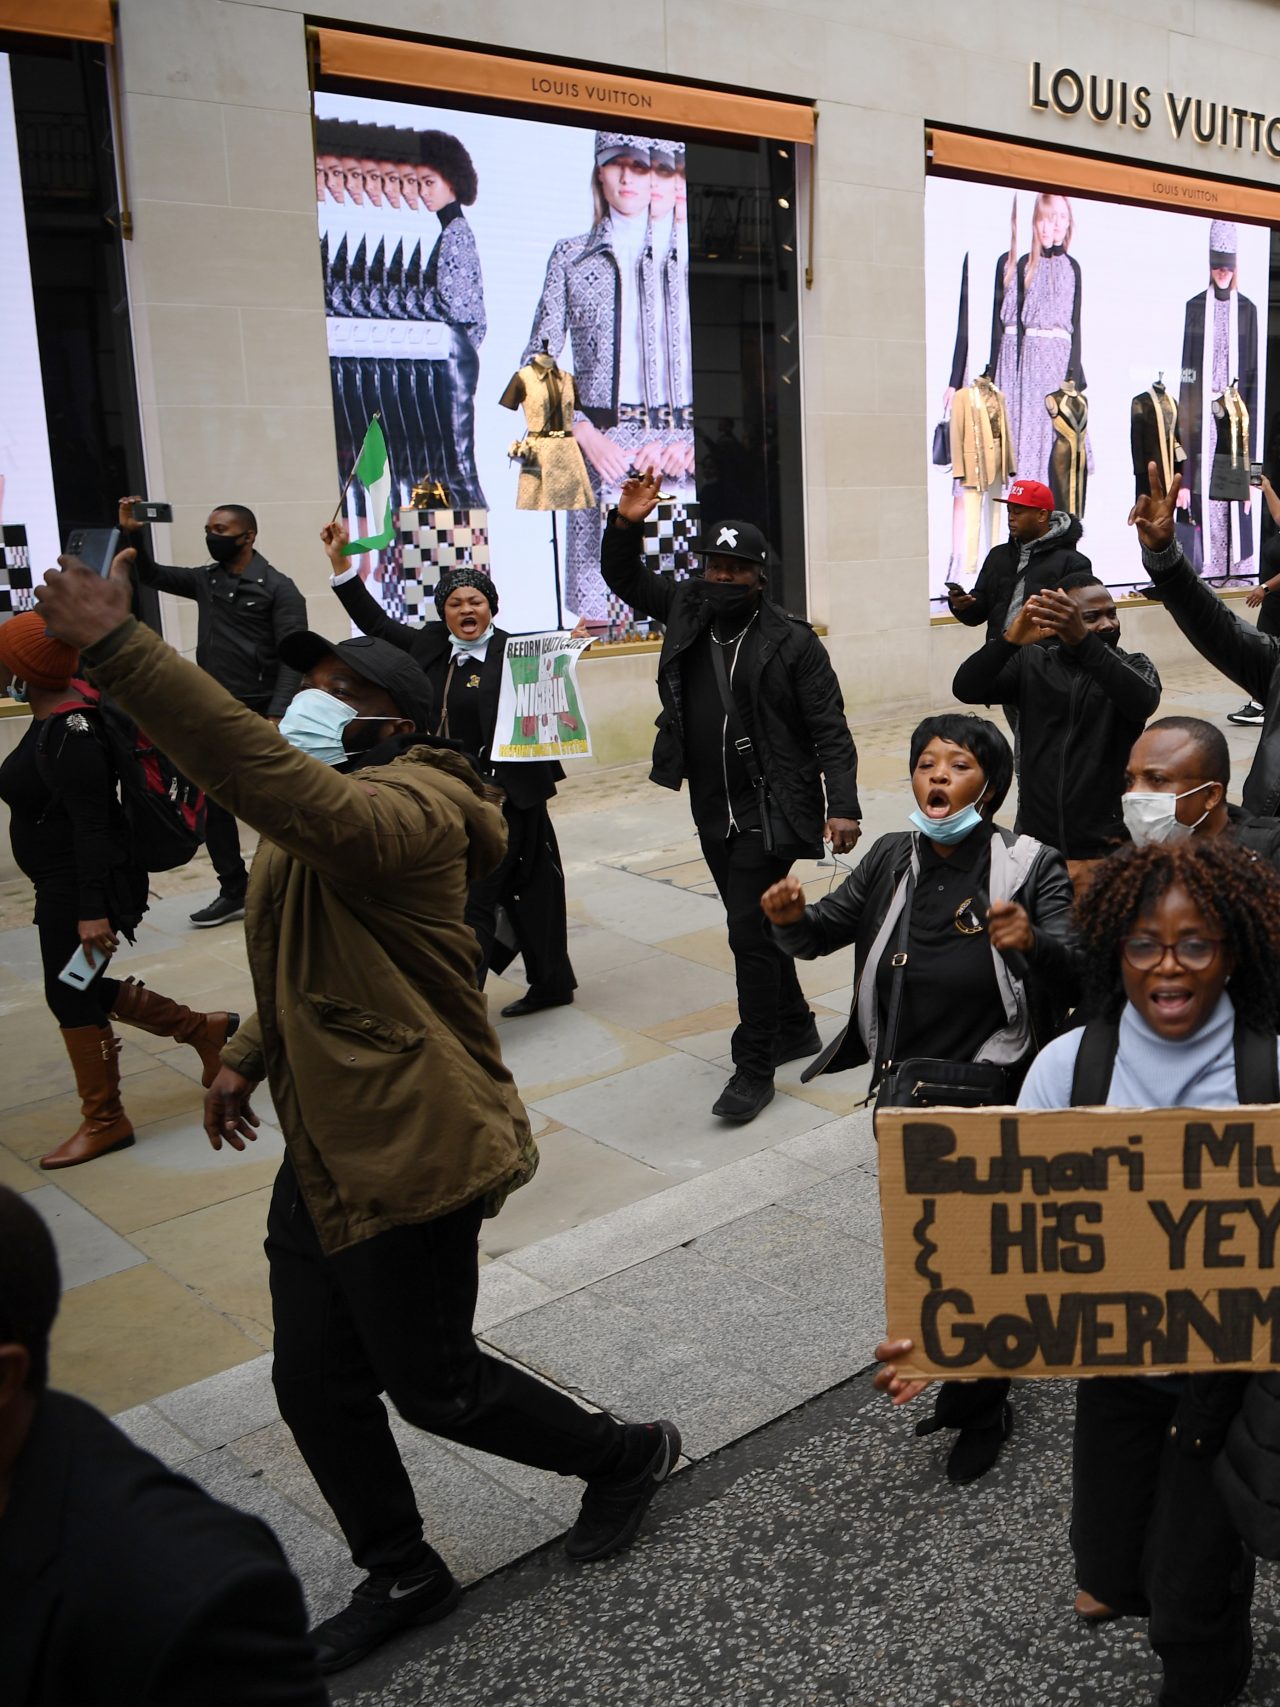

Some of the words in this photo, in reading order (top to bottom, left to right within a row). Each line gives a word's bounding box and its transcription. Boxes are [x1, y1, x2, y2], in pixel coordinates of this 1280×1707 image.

[532, 78, 579, 97] LOUIS
[585, 86, 652, 108] VUITTON
[1030, 62, 1152, 130] LOUIS
[1152, 182, 1179, 196] LOUIS
[1181, 187, 1218, 202] VUITTON
[506, 640, 541, 659] REFORM
[516, 677, 570, 718] NIGERIA
[902, 1118, 1145, 1196] Buhari
